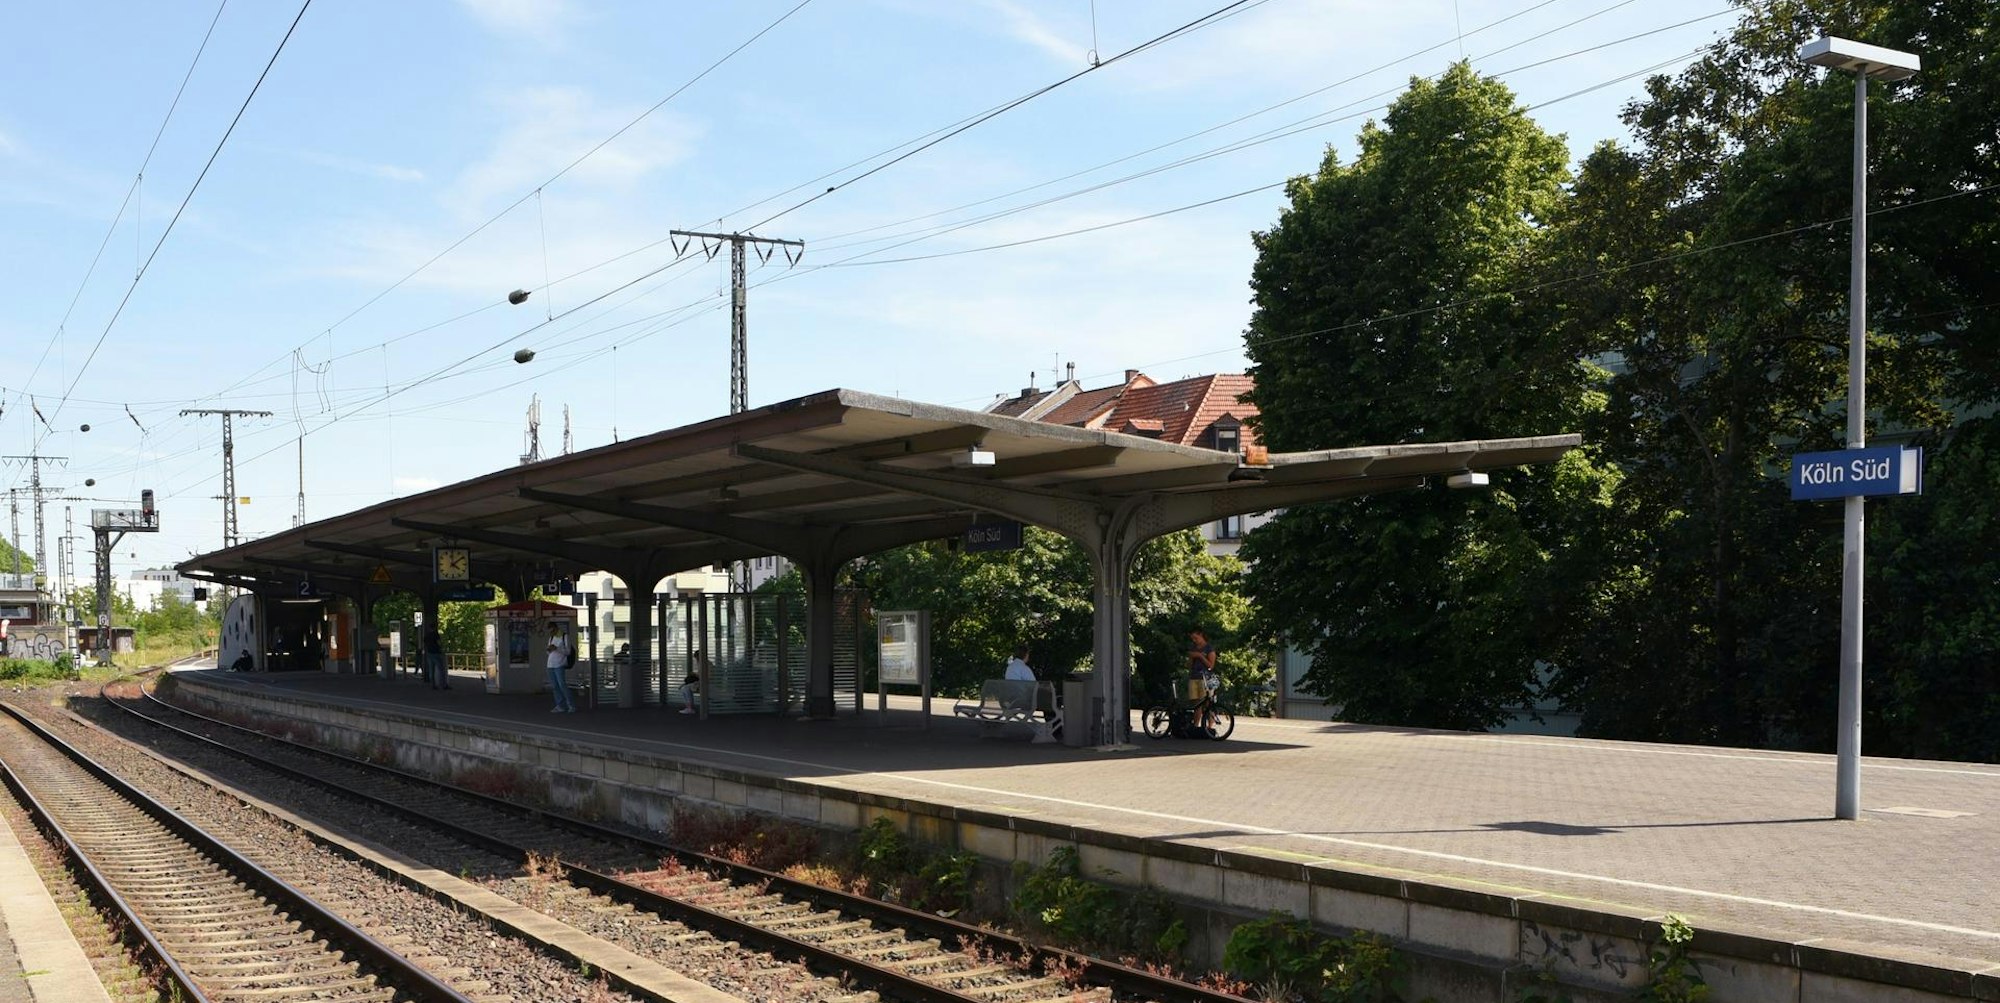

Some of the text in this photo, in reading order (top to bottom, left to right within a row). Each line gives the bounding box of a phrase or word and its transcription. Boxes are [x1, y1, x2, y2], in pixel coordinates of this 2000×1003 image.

[1800, 457, 1891, 485] Köln Süd
[968, 527, 1001, 544] Köln Süd
[300, 581, 311, 596] 2
